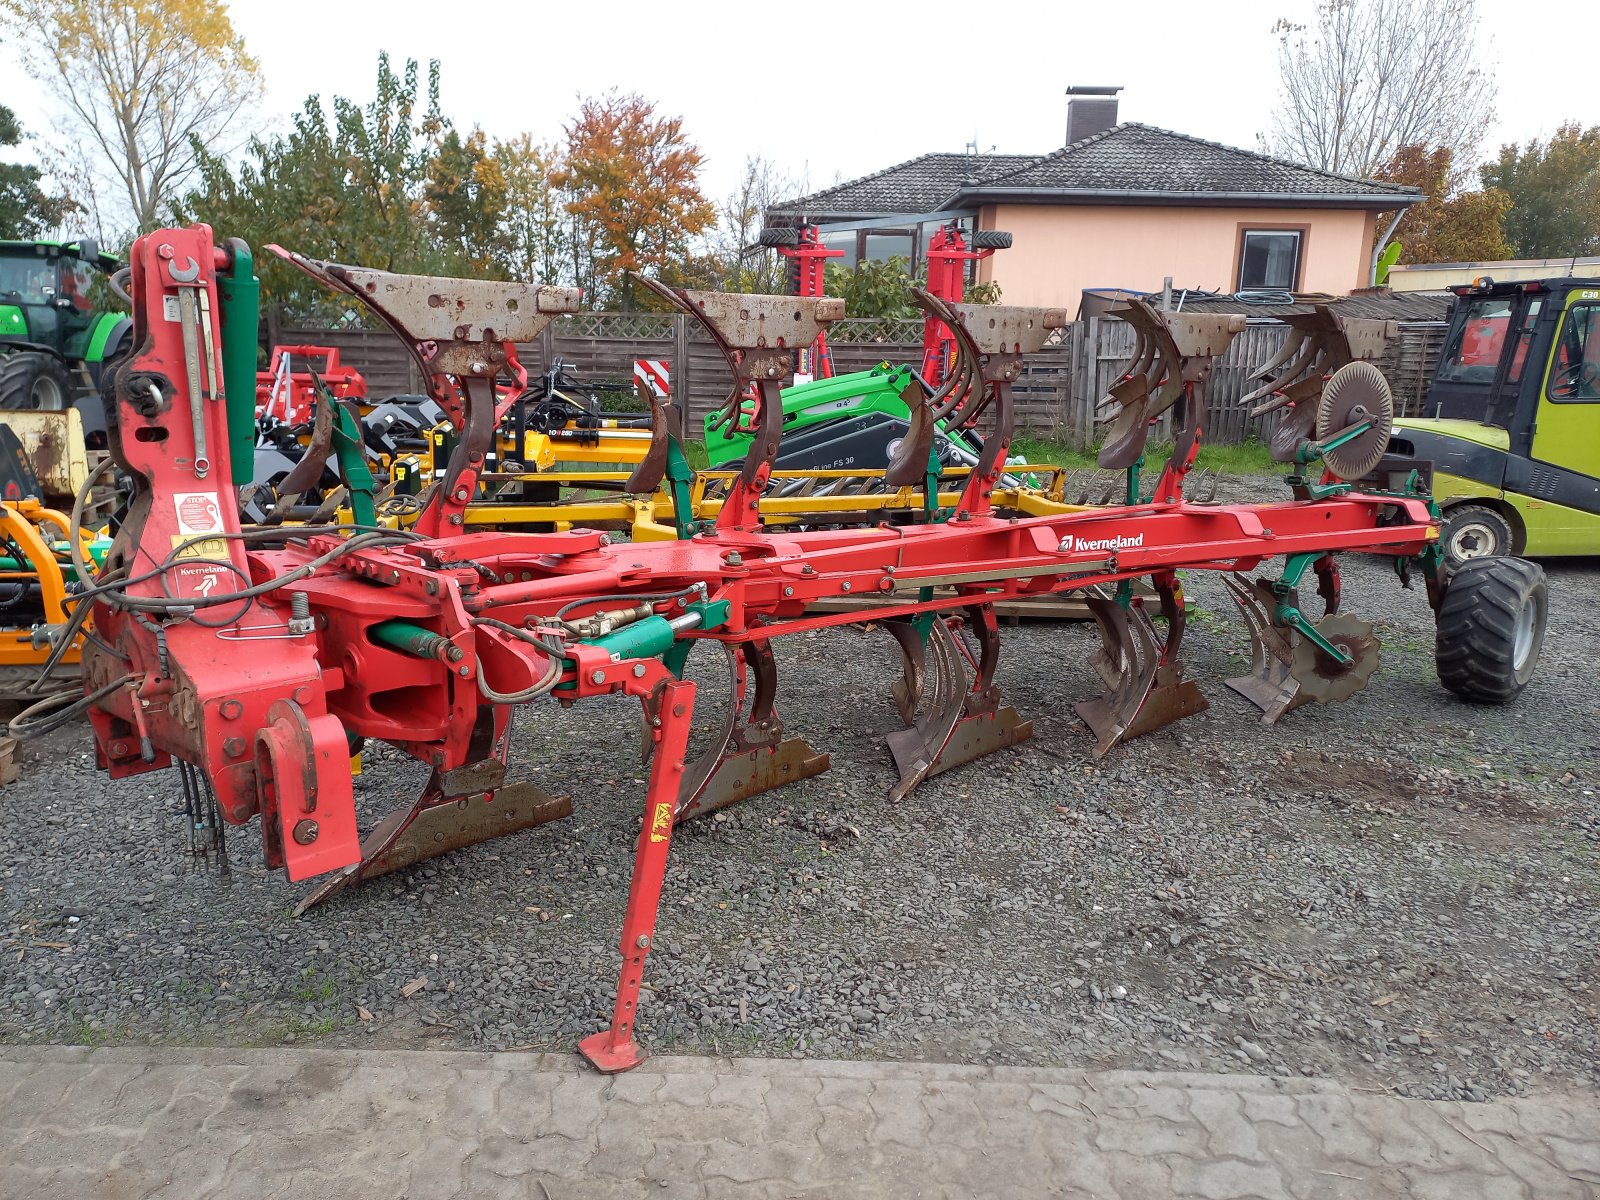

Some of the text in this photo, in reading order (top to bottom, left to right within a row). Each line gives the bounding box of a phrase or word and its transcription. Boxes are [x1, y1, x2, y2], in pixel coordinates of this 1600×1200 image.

[833, 458, 844, 468] FS
[845, 456, 855, 465] 30
[1075, 533, 1143, 551] Kverneland
[180, 566, 228, 575] Kverneland
